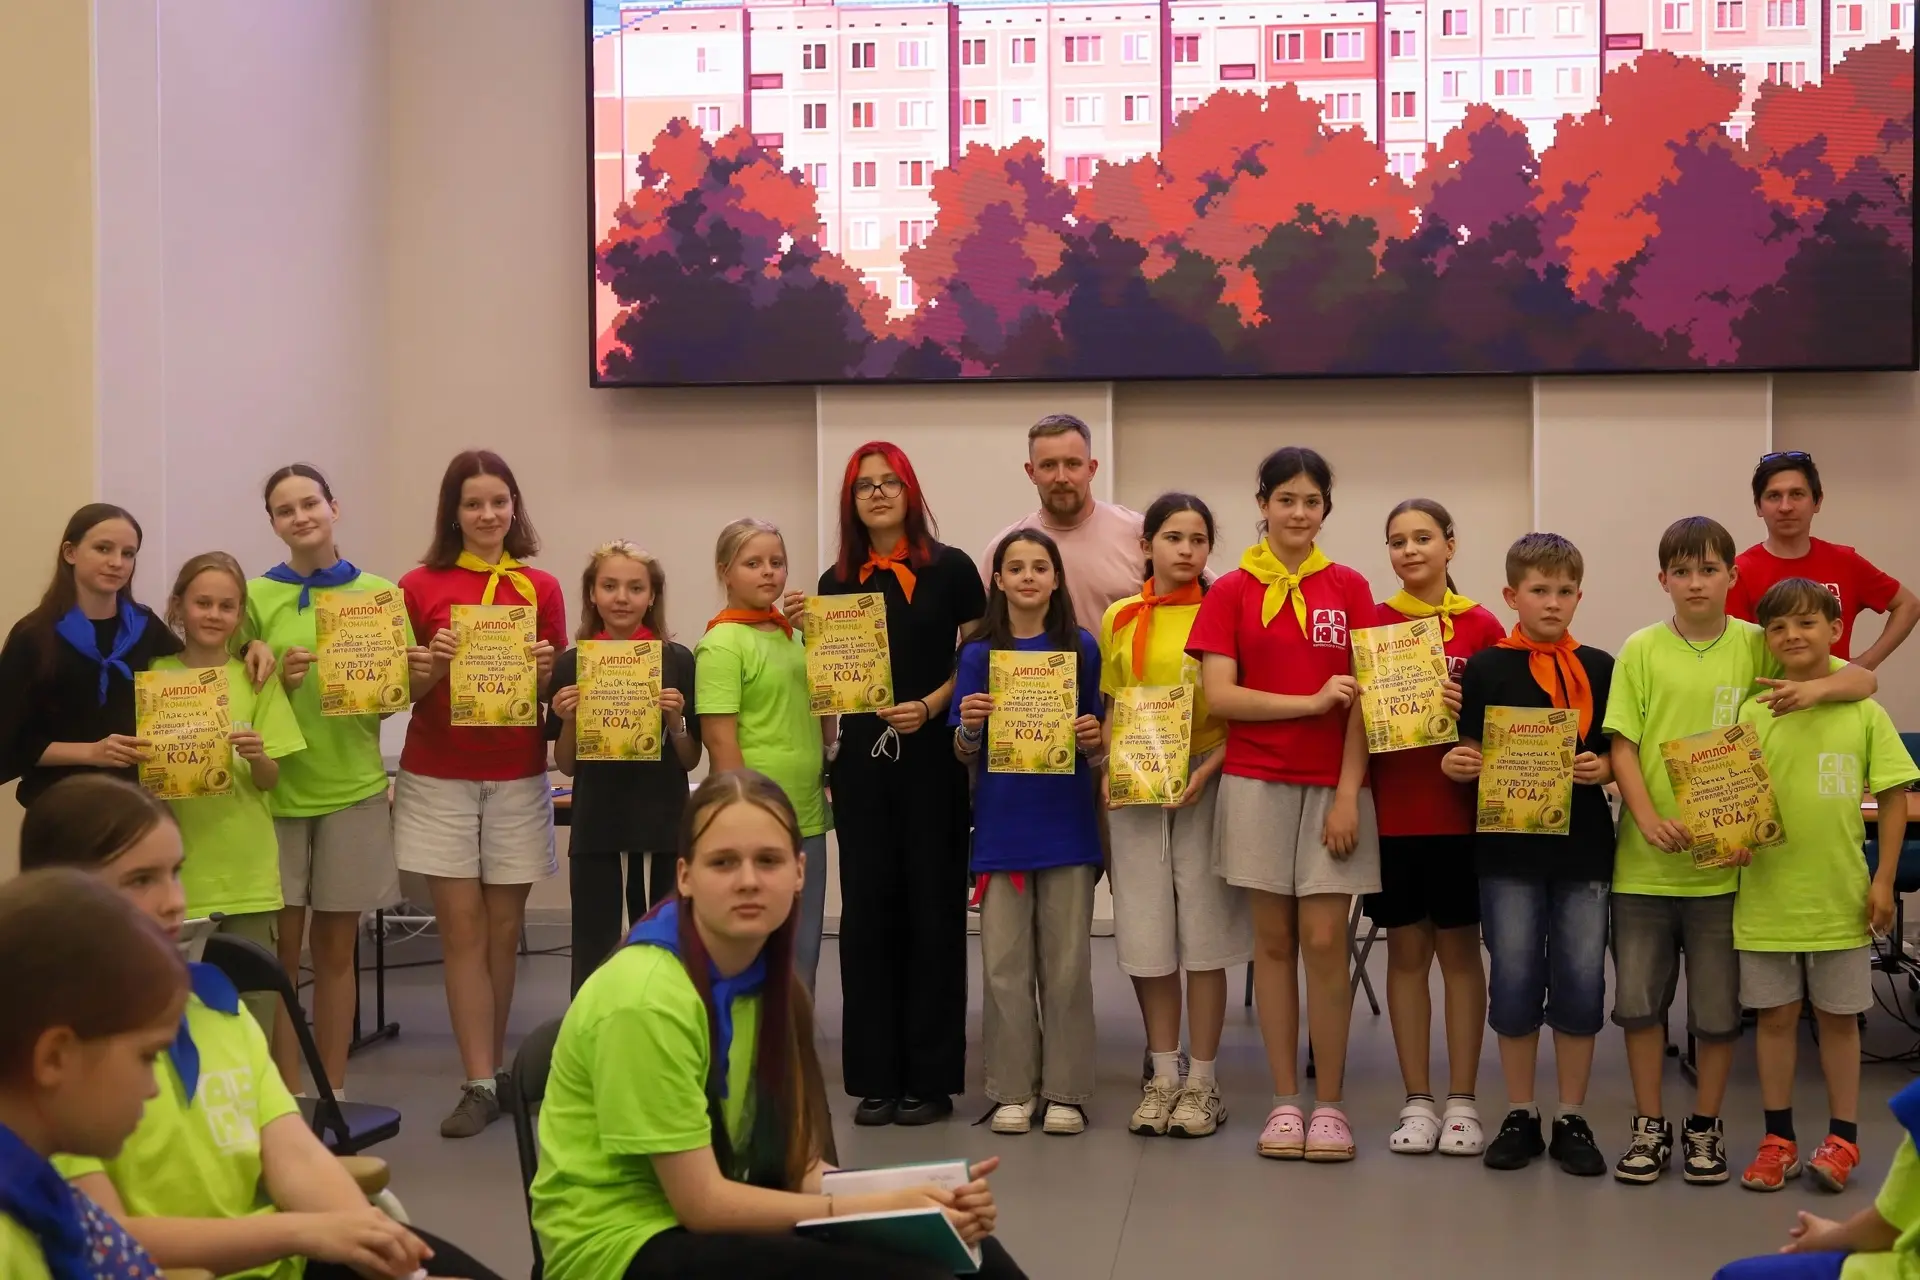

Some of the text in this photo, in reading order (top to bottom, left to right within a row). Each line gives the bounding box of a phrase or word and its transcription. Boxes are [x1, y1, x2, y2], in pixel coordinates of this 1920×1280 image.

[340, 606, 382, 617] ДИПЛОМ
[826, 610, 865, 621] ДИПЛОМ
[474, 621, 515, 631] ДИПЛОМ
[471, 643, 513, 654] Мегамозг
[1377, 637, 1420, 653] ДИПЛОМ
[600, 656, 640, 665] ДИПЛОМ
[1381, 652, 1417, 662] КОМАНДА
[335, 658, 391, 669] КУЛЬТУРНЫЙ
[823, 659, 875, 670] КУЛЬТУРНЫЙ
[347, 669, 375, 681] КОД
[467, 672, 521, 681] КУЛЬТУРНЫЙ
[834, 670, 861, 682] КОД
[1013, 667, 1054, 676] ДИПЛОМ
[161, 685, 206, 698] ДИПЛОМ
[477, 682, 505, 694] КОД
[1378, 688, 1434, 705] КУЛЬТУРНЫЙ
[165, 700, 202, 708] КОМАНДА
[1136, 702, 1175, 711] ДИПЛОМ
[1390, 701, 1420, 716] КОД
[593, 707, 646, 716] КУЛЬТУРНЫЙ
[603, 717, 630, 729] КОД
[1005, 720, 1059, 728] КУЛЬТУРНЫЙ
[1509, 724, 1554, 734] ДИПЛОМ
[1015, 729, 1043, 741] КОД
[155, 739, 215, 751] КУЛЬТУРНЫЙ
[167, 752, 198, 764] КОД
[1691, 744, 1736, 764] ДИПЛОМ
[1134, 761, 1160, 772] КОД
[1698, 760, 1736, 773] КОМАНДА
[1497, 779, 1555, 787] КУЛЬТУРНЫЙ
[1508, 788, 1536, 800] КОД
[1699, 795, 1759, 818] КУЛЬТУРНЫЙ
[1713, 811, 1745, 828] КОД
